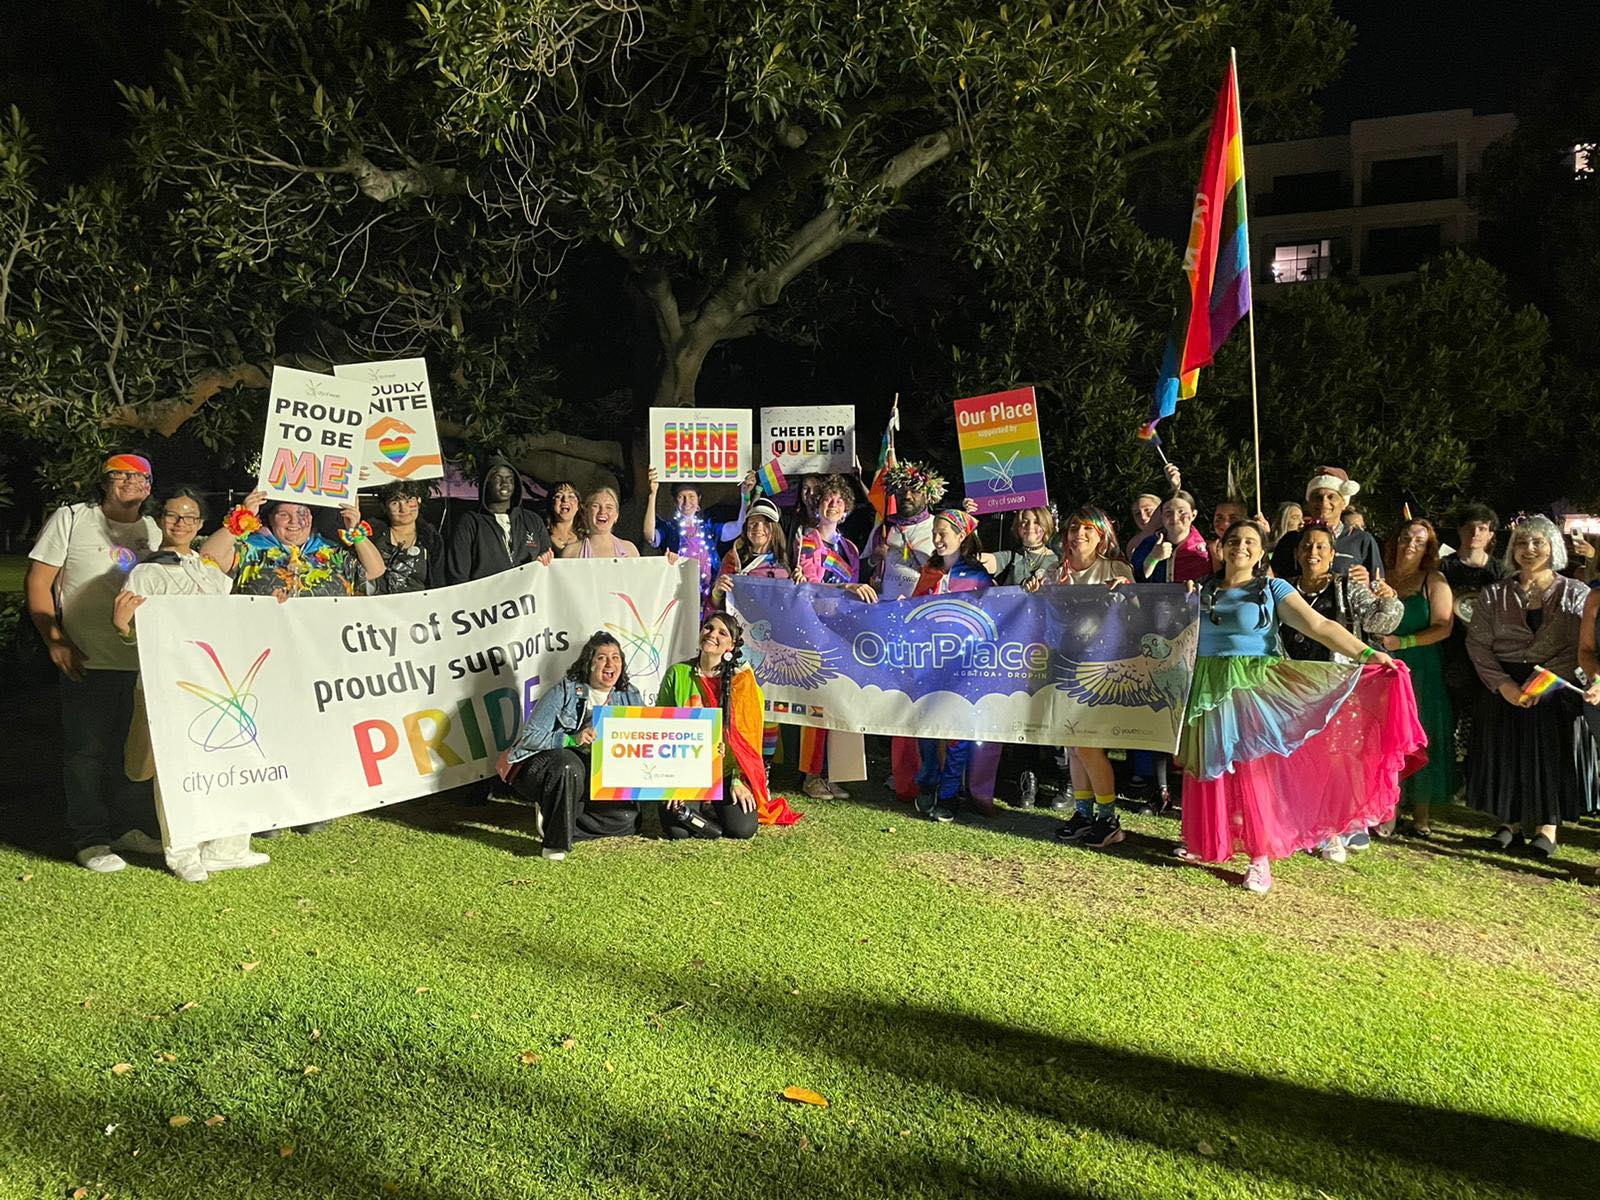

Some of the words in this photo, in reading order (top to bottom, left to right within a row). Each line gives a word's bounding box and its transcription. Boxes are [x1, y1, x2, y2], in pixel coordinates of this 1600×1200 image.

[371, 381, 424, 396] OUDLY
[275, 398, 363, 426] PROUD
[369, 394, 428, 415] NITE
[960, 410, 986, 427] Our
[990, 402, 1032, 422] Place
[279, 423, 312, 442] TO
[321, 430, 353, 449] BE
[665, 422, 738, 451] SHINE
[770, 425, 815, 438] CHEER
[818, 425, 846, 437] FOR
[771, 438, 845, 458] QUEER
[268, 447, 353, 499] ME
[665, 451, 738, 478] PROUD
[1006, 495, 1026, 505] swan
[341, 622, 398, 657] City
[409, 611, 442, 645] of
[451, 592, 537, 636] Swan
[852, 631, 1049, 670] OurPlace
[313, 660, 436, 712] proudly
[448, 626, 570, 680] supports
[611, 731, 659, 740] DIVERSE
[661, 731, 704, 741] PEOPLE
[611, 743, 654, 758] ONE
[658, 743, 704, 759] CITY
[182, 771, 214, 795] city
[217, 764, 237, 788] of
[239, 764, 288, 785] swan
